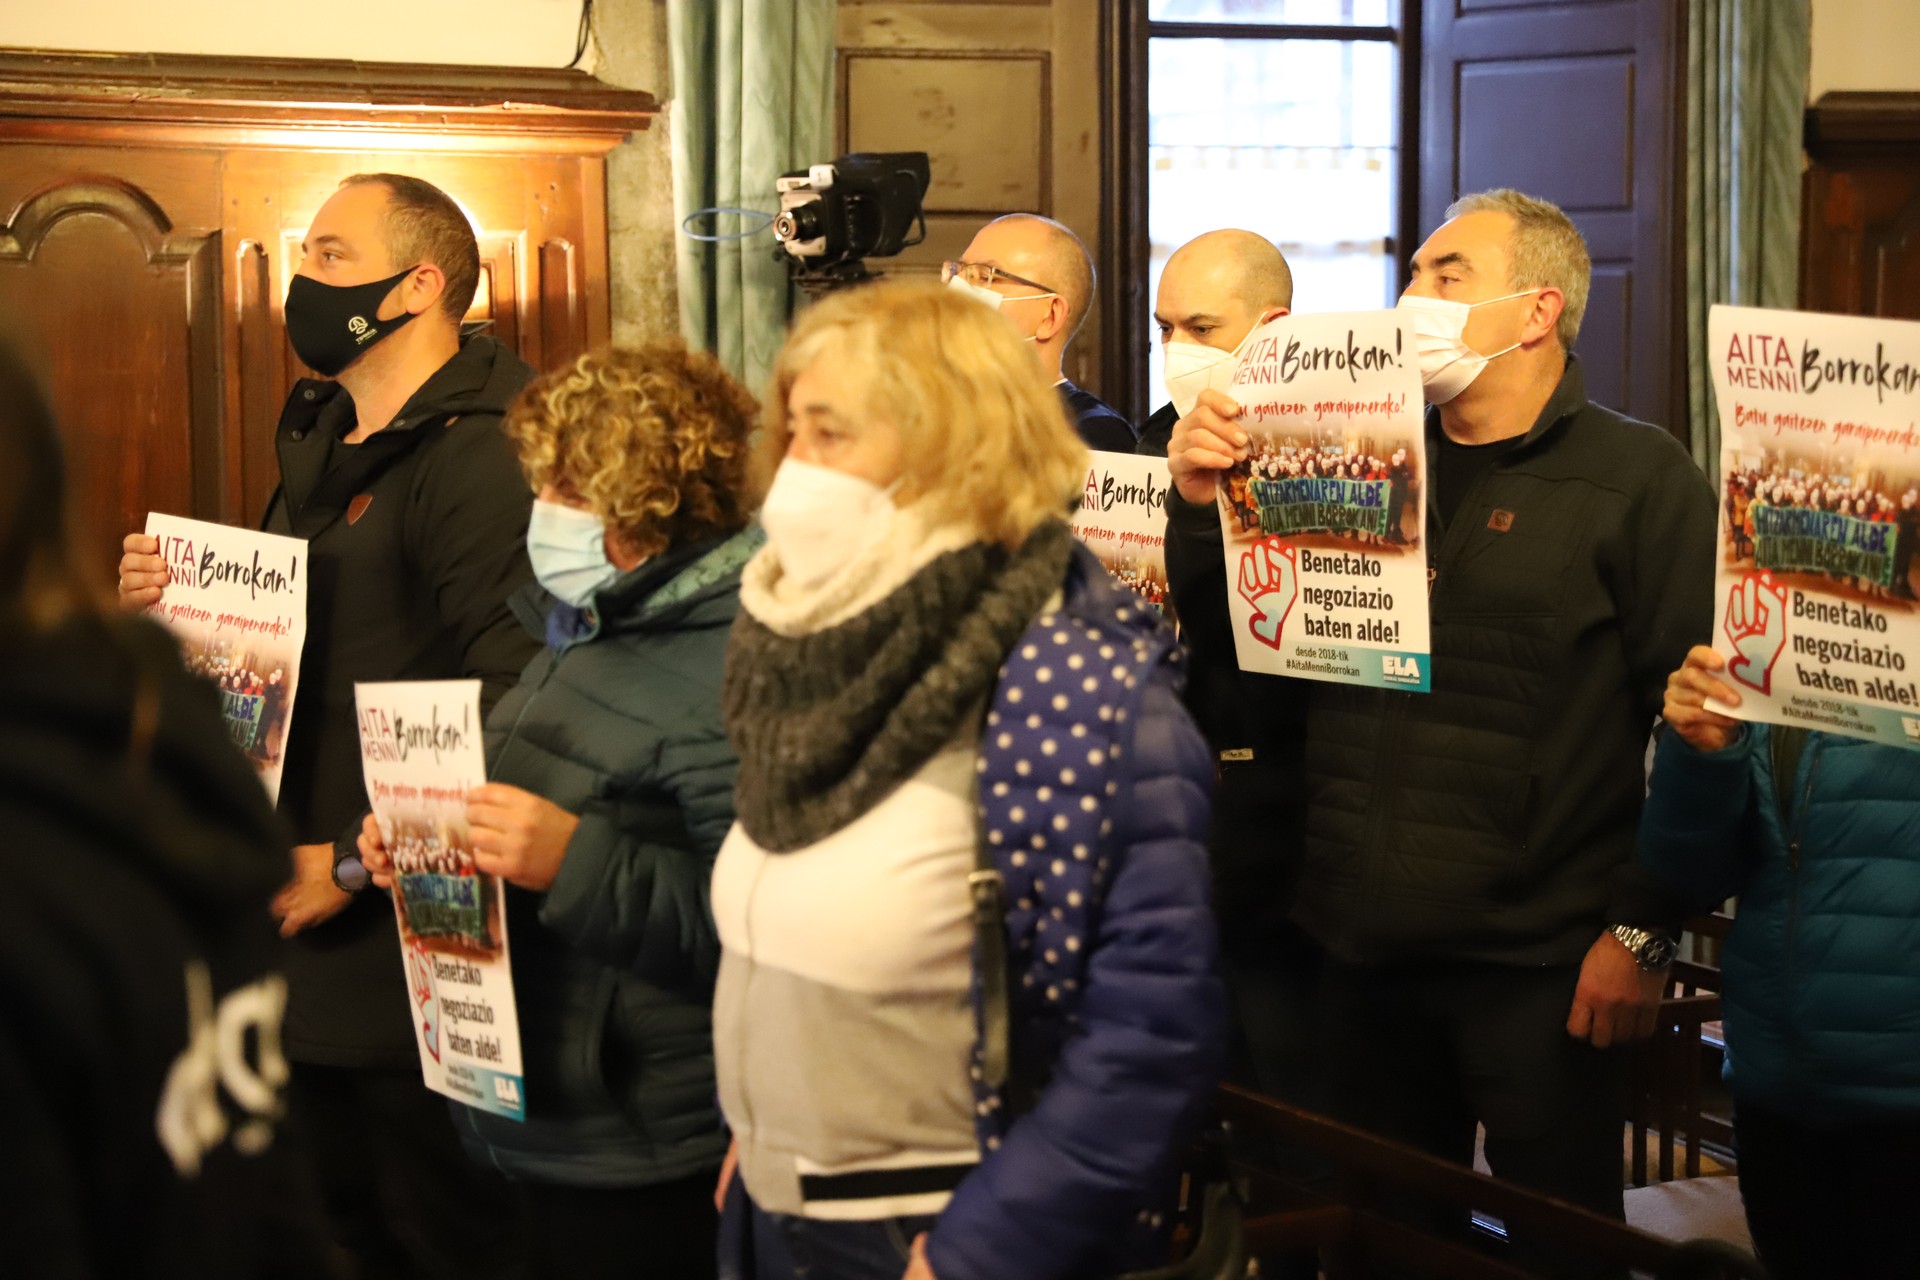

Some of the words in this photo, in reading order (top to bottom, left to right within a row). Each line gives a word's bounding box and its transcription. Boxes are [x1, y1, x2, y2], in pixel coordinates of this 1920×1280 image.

[1239, 336, 1277, 367] AITA
[1280, 327, 1403, 383] Borrokan!
[1727, 333, 1794, 368] AITA
[1230, 364, 1277, 384] MENNI
[1727, 366, 1797, 393] MENNI
[1254, 399, 1307, 422] gaitezen
[1313, 392, 1405, 421] garaipenerako!
[1735, 401, 1767, 427] Batu
[1773, 412, 1826, 436] gaitezen
[1350, 480, 1383, 507] ALDE
[1082, 525, 1115, 543] gaitezen
[166, 563, 195, 587] NNI
[199, 543, 296, 600] Borrokan!
[1301, 549, 1381, 577] Benetako
[1303, 585, 1393, 611] negoziazio
[1792, 591, 1887, 632] Benetako
[170, 602, 212, 622] gaitezen
[216, 612, 291, 640] garaipenerako!
[1304, 613, 1351, 639] baten
[1356, 618, 1399, 644] alde!
[1295, 646, 1316, 658] desde
[1318, 649, 1348, 661] 2018-tik
[1381, 655, 1420, 677] ELA
[1792, 633, 1905, 671] negoziazio
[1285, 659, 1360, 676] #AitaMenniBorrokan
[1795, 662, 1858, 695] baten
[1863, 677, 1920, 707] alde!
[358, 708, 392, 737] AITA
[392, 703, 469, 766] Borrokan!
[431, 953, 482, 986] Benetako
[440, 996, 493, 1024] negoziazio
[475, 1036, 502, 1062] alde!
